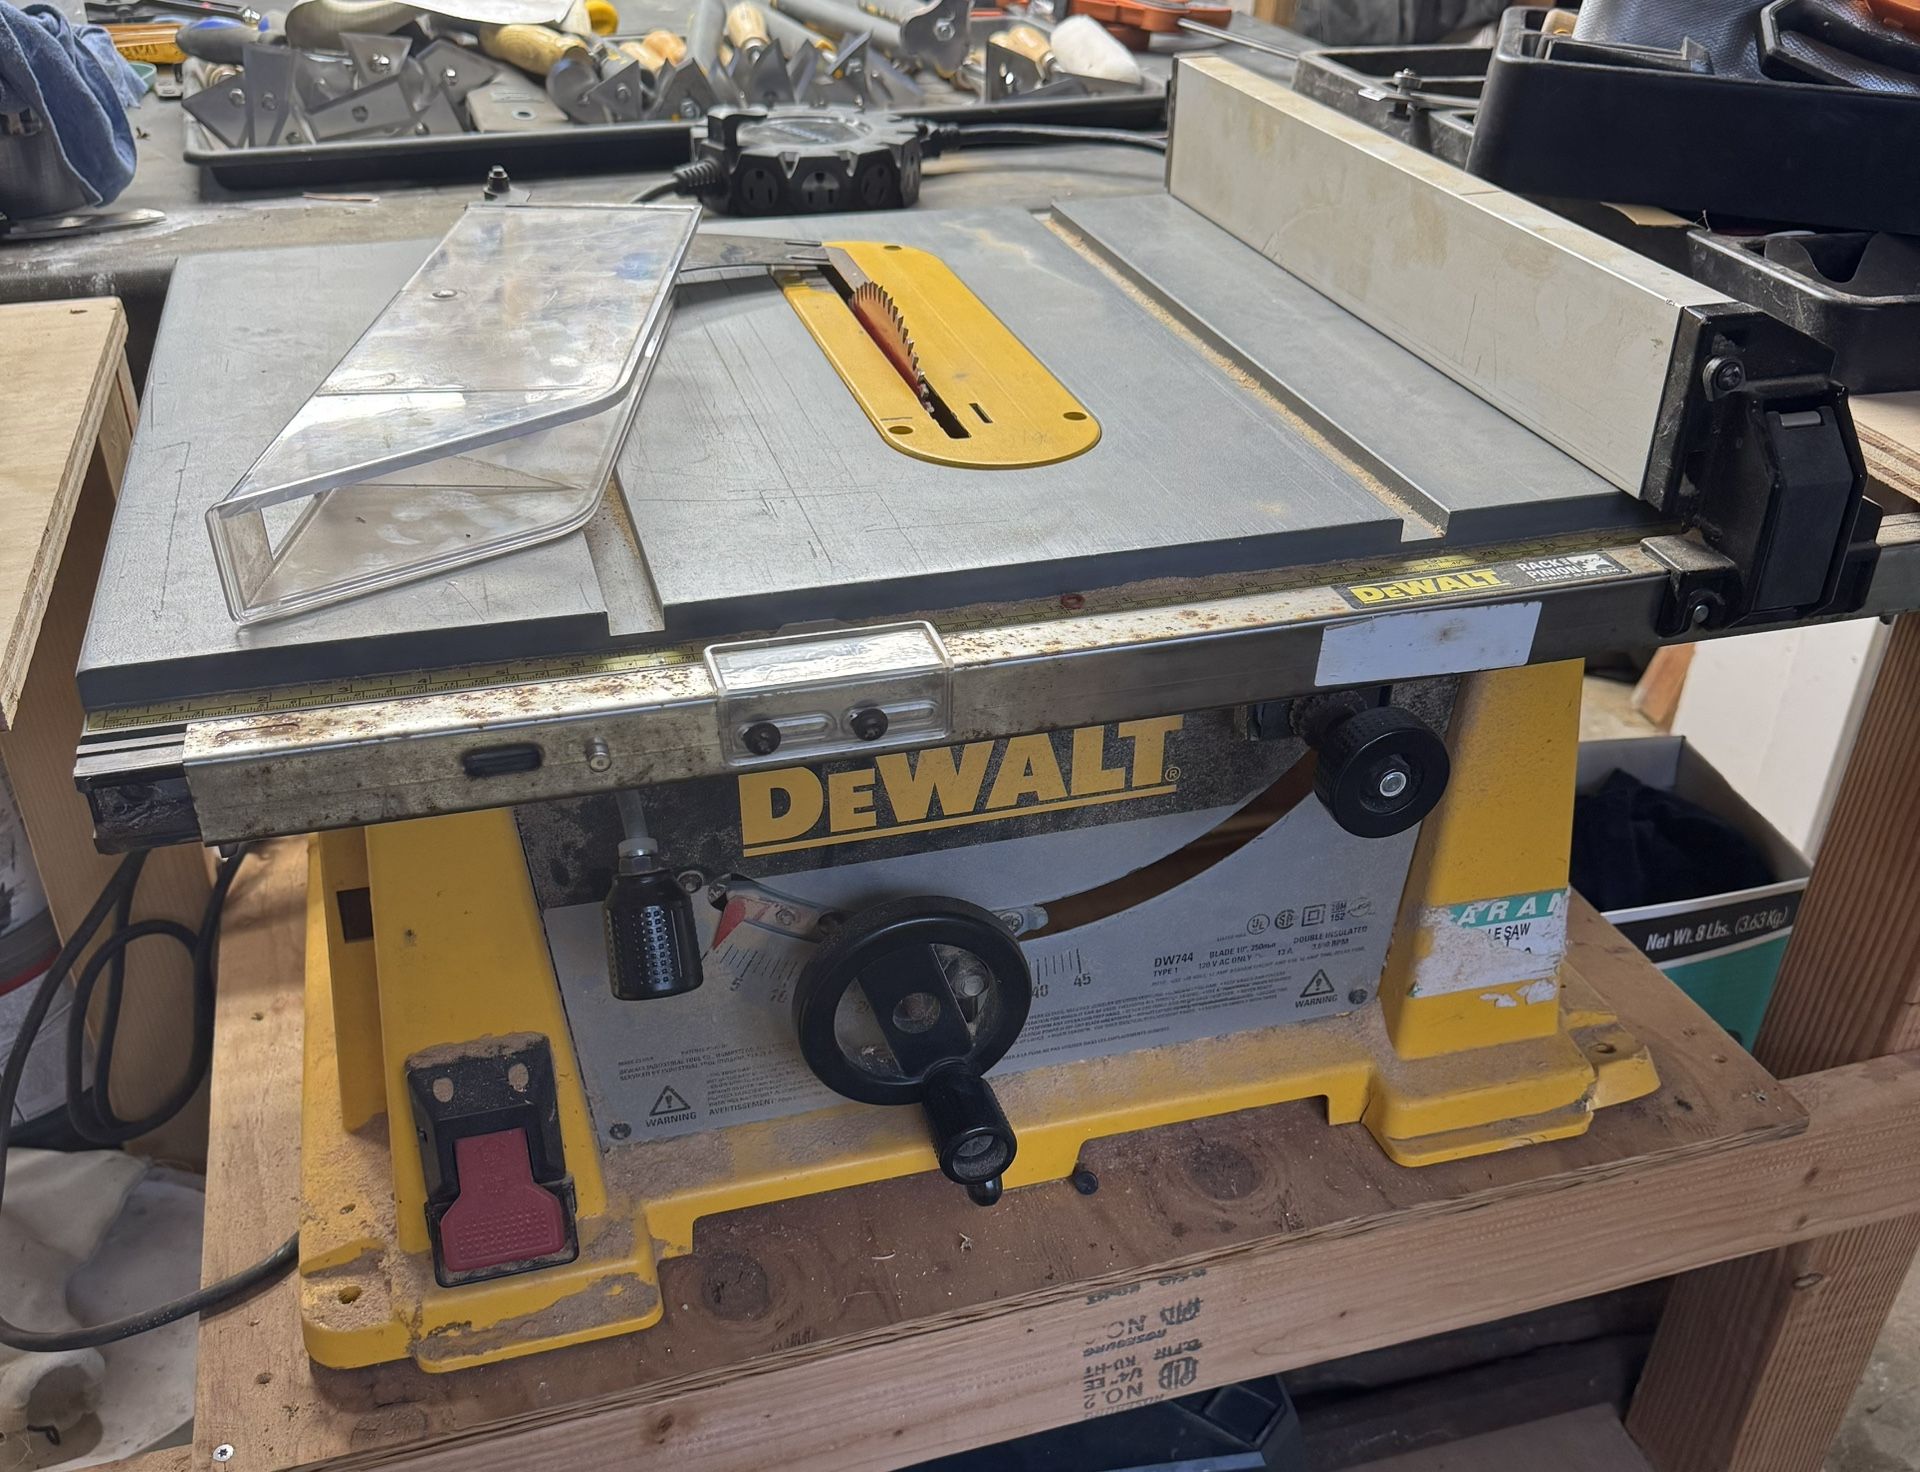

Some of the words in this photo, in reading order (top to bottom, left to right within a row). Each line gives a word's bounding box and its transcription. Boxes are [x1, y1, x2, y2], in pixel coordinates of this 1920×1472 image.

[1516, 559, 1562, 571] RACK
[1526, 565, 1581, 578] PINION
[1293, 932, 1323, 945] DOUBLE
[1323, 926, 1368, 940] INSULATED
[1504, 922, 1531, 939] SAW
[1645, 932, 1670, 951] Net
[1673, 927, 1693, 946] Wt.
[1695, 924, 1706, 941] 8
[1706, 919, 1730, 939] Lbs.
[1209, 946, 1236, 958] BLADE
[1154, 952, 1194, 968] DW744
[1219, 957, 1231, 968] AC
[1231, 954, 1253, 966] ONLY
[1153, 967, 1173, 977] TYPE
[730, 977, 743, 991] 5
[1073, 973, 1092, 987] 45
[1032, 984, 1049, 999] 40
[1294, 993, 1339, 1009] WARNING
[645, 1111, 697, 1128] WARNING
[1102, 1381, 1144, 1404] NO.
[1083, 1393, 1096, 1410] 2
